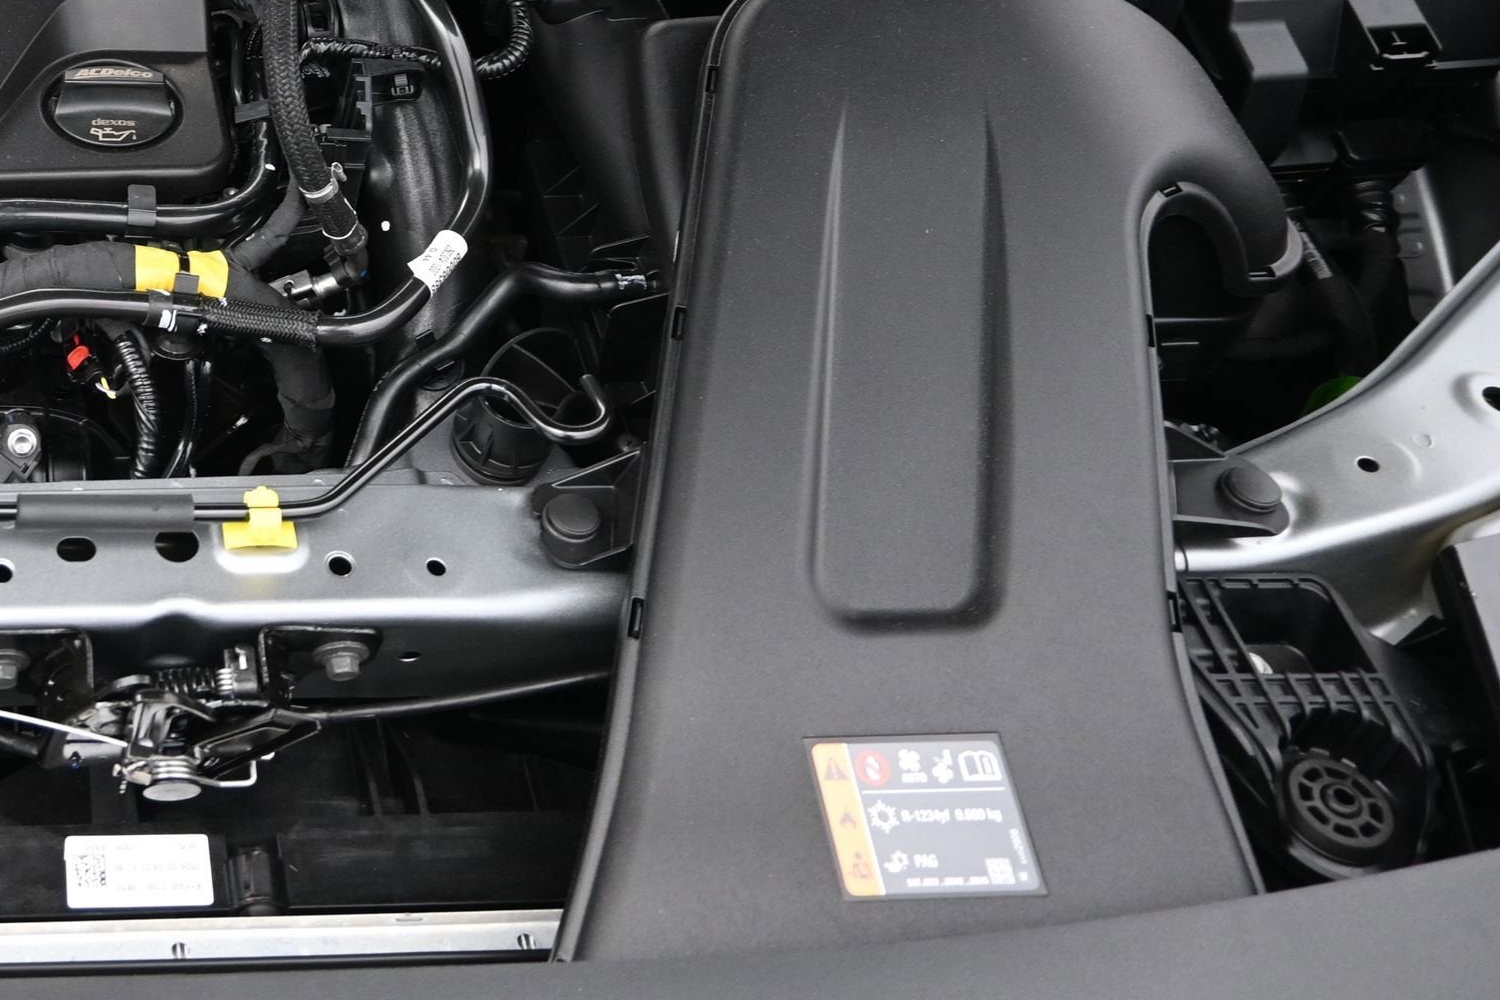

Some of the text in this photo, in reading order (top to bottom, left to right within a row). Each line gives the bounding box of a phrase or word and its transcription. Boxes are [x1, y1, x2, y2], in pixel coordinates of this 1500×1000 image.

[75, 68, 153, 79] ACDelco
[92, 118, 137, 126] dexos
[914, 853, 939, 868] PAG
